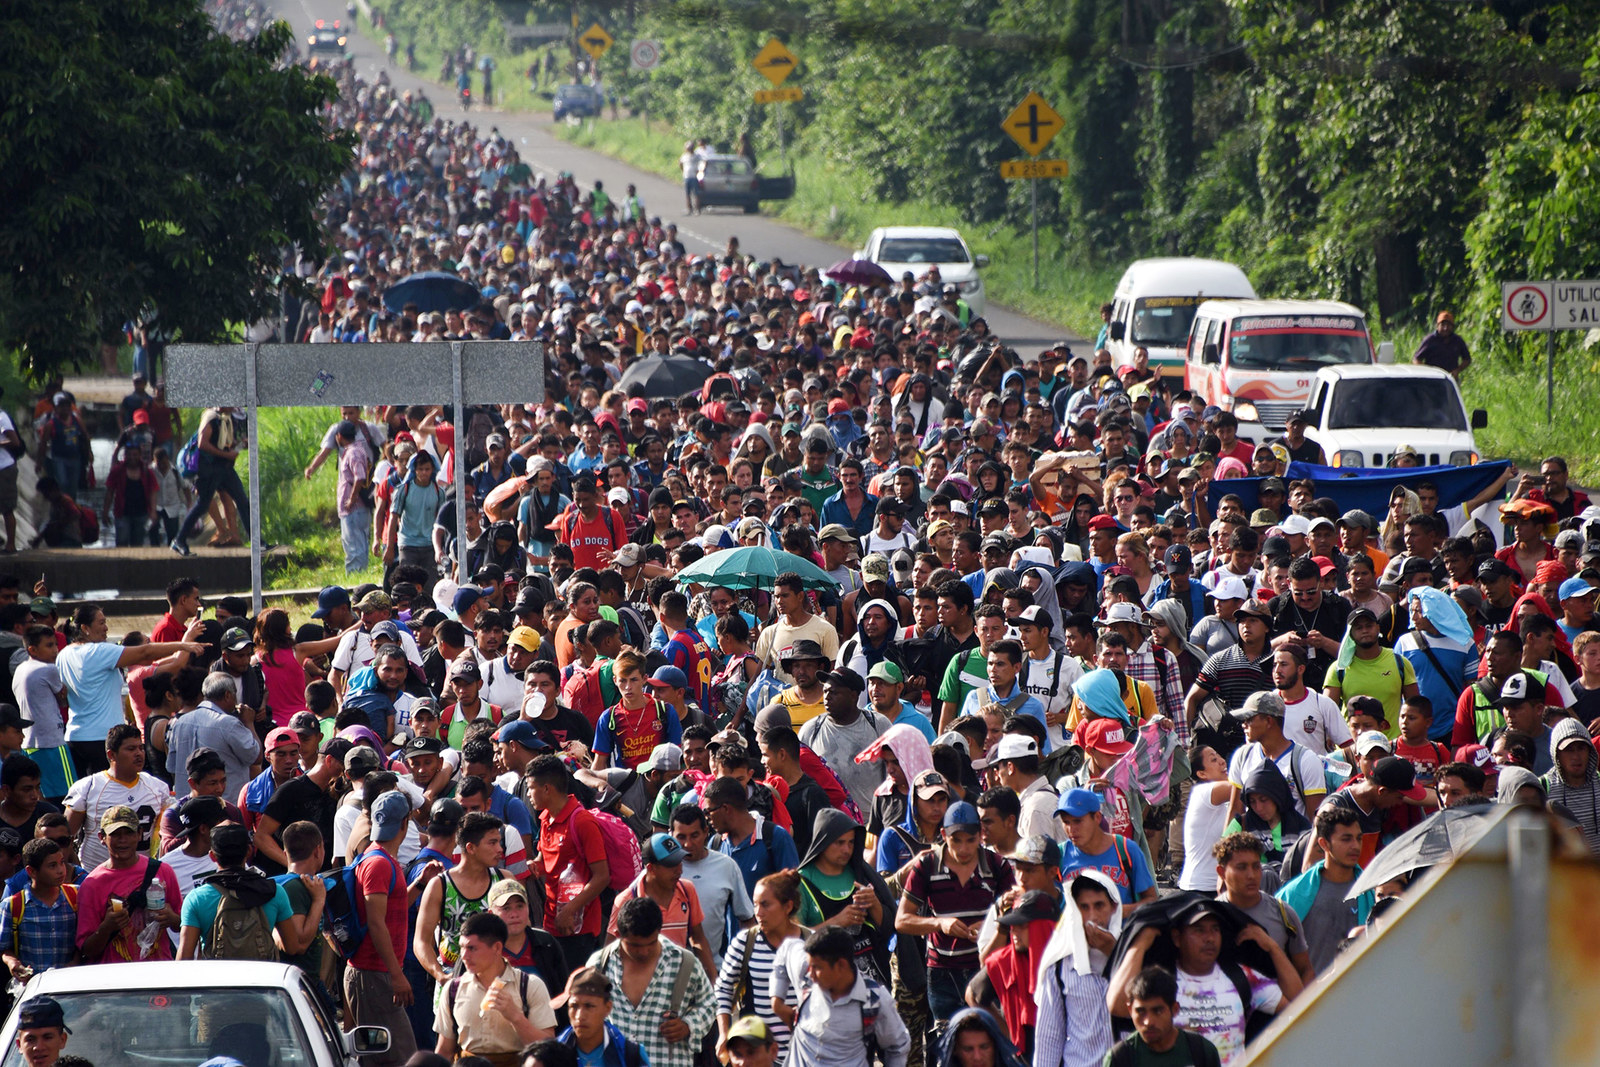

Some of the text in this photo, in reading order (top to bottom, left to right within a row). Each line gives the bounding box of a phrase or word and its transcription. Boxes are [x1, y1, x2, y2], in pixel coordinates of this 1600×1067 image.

[1297, 379, 1309, 388] 01
[570, 536, 609, 548] GO DOGS
[624, 733, 656, 750] Qatar
